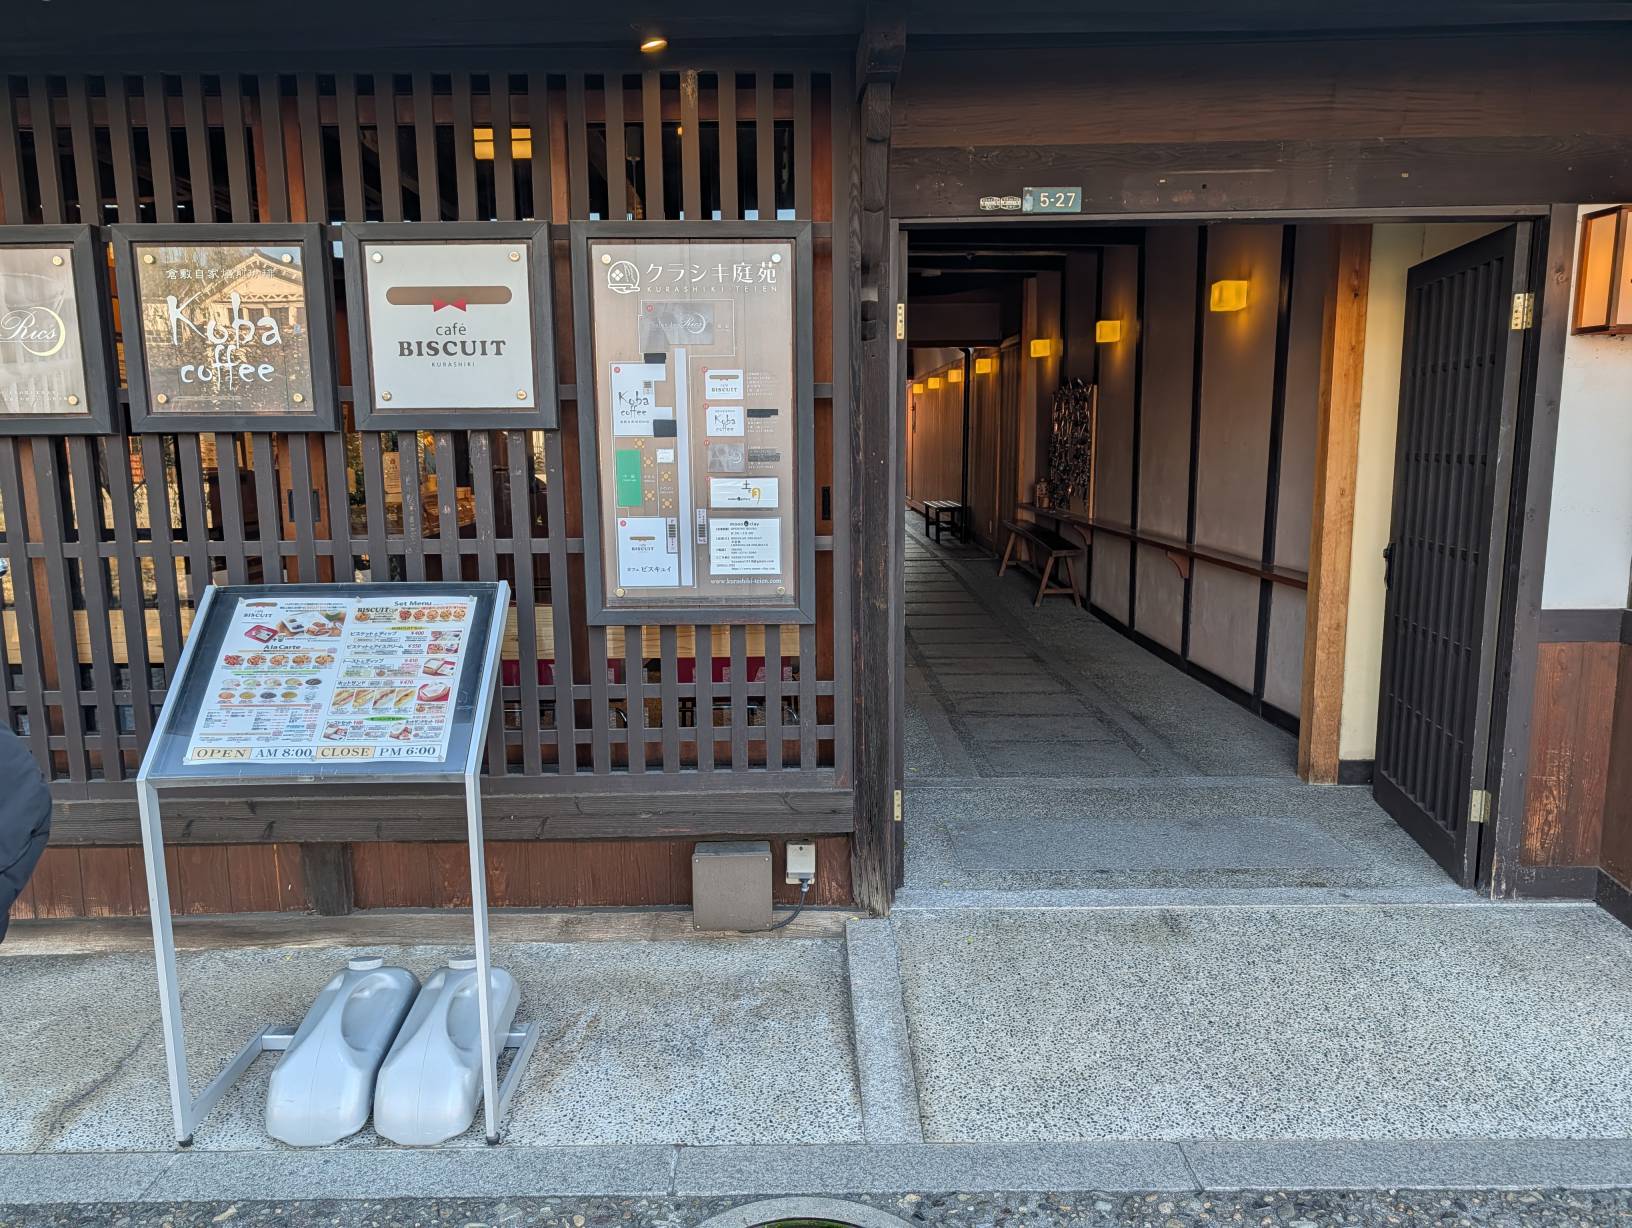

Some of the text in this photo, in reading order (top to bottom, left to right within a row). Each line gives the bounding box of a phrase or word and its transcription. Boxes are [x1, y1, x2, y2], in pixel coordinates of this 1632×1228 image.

[1039, 192, 1076, 207] 5-27
[646, 262, 777, 284] クラシキ庭苑
[166, 289, 282, 349] Koba
[435, 322, 467, 336] café
[397, 340, 507, 357] BISCUIT
[180, 344, 275, 391] coffee
[618, 390, 650, 409] Koba
[620, 404, 648, 418] coffee
[196, 748, 313, 758] OPEN AM 8:00
[321, 746, 436, 758] CLOSE PM 6:00
